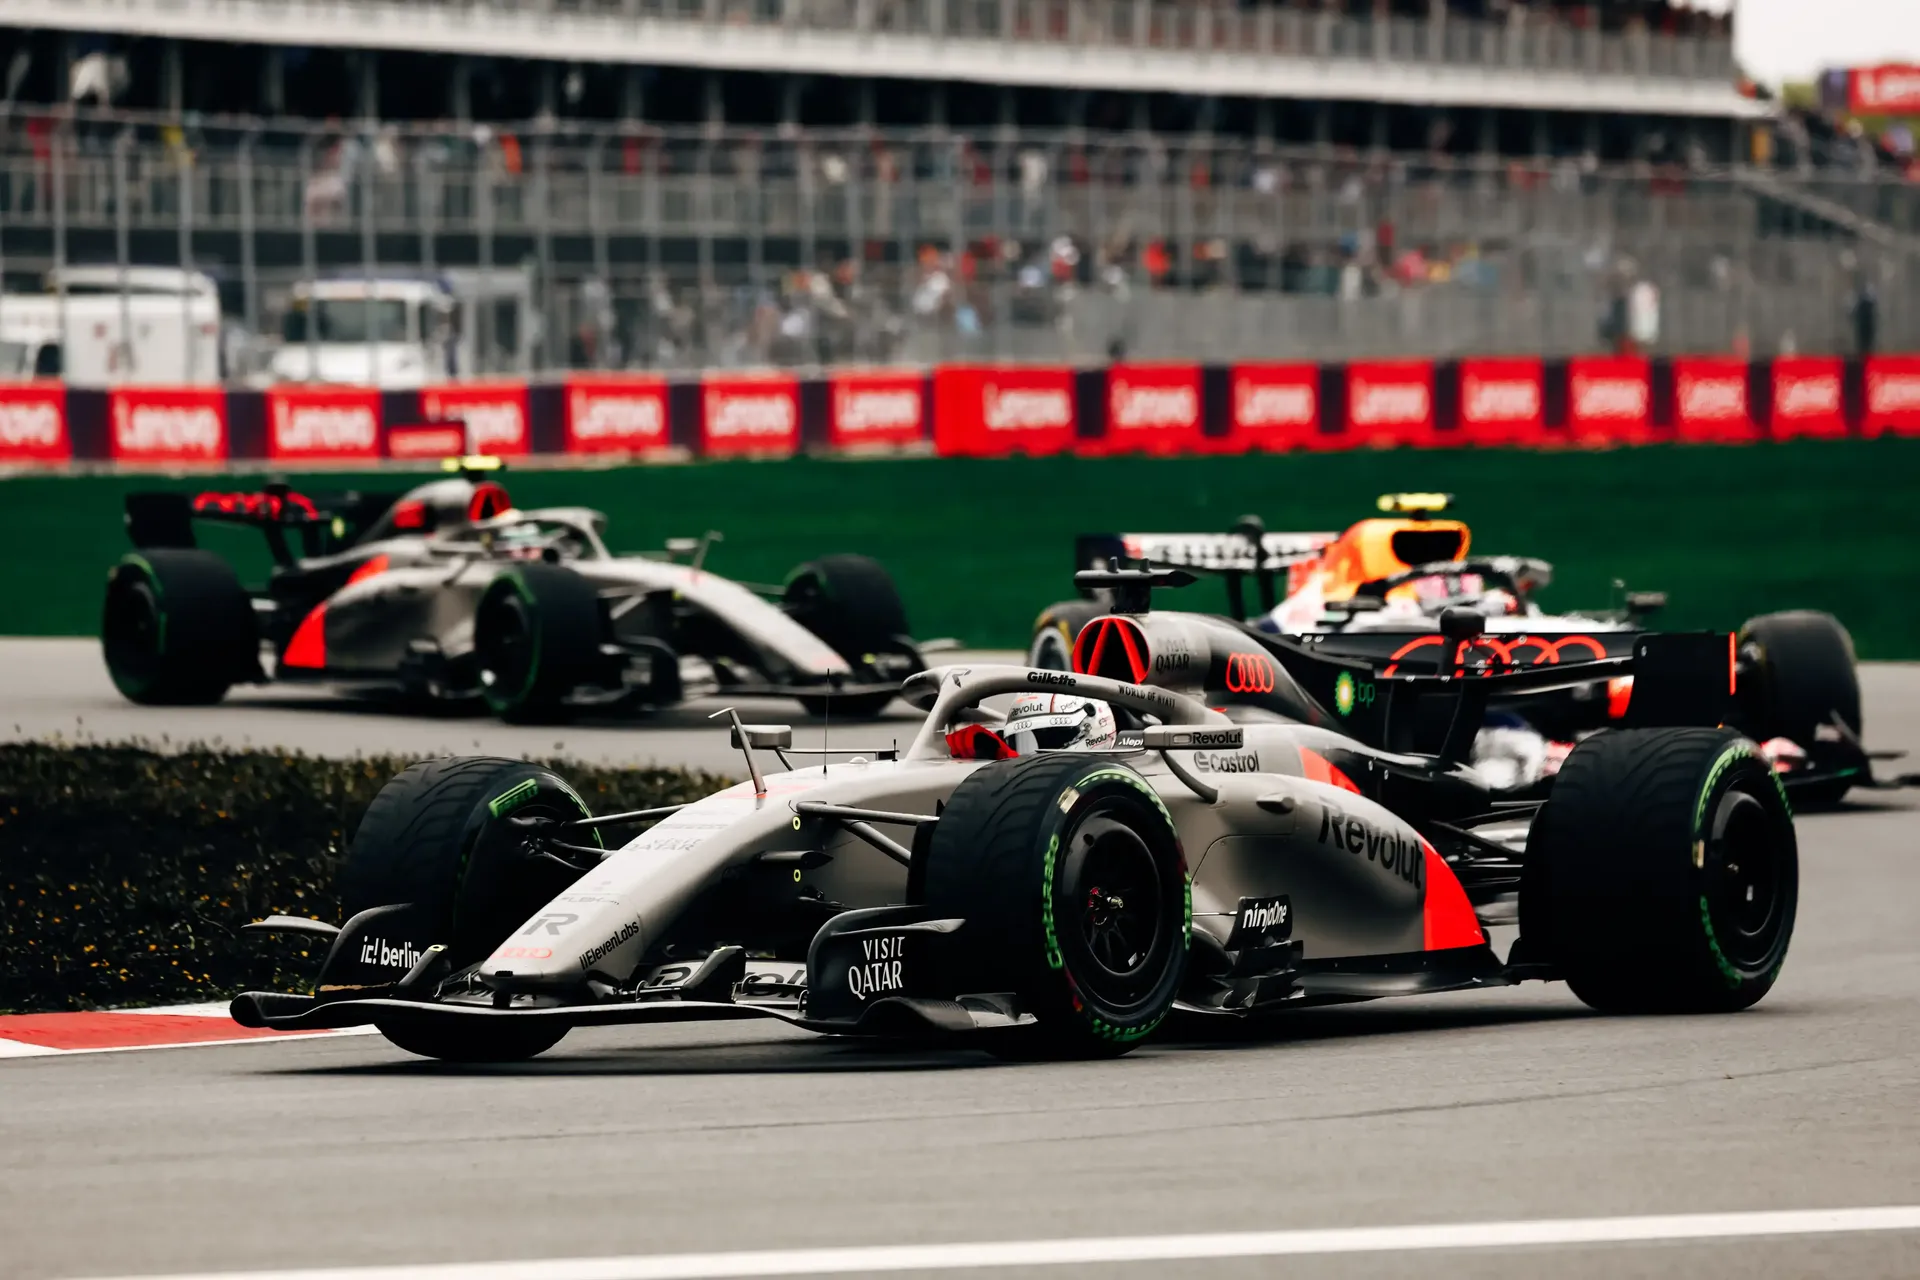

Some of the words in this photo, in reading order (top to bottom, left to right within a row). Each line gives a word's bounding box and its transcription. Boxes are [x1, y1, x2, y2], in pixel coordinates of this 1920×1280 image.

[1155, 653, 1190, 674] QATAR
[1027, 671, 1077, 687] Gillette
[1118, 685, 1145, 699] WORLD
[1147, 691, 1156, 701] OF
[1358, 680, 1375, 708] bp
[1192, 731, 1242, 744] Revolut
[1210, 750, 1260, 773] Castrol
[1318, 800, 1423, 889] Revolut
[360, 936, 379, 965] ic!
[380, 938, 421, 969] berlin
[863, 936, 906, 960] VISIT
[848, 960, 903, 1000] QATAR
